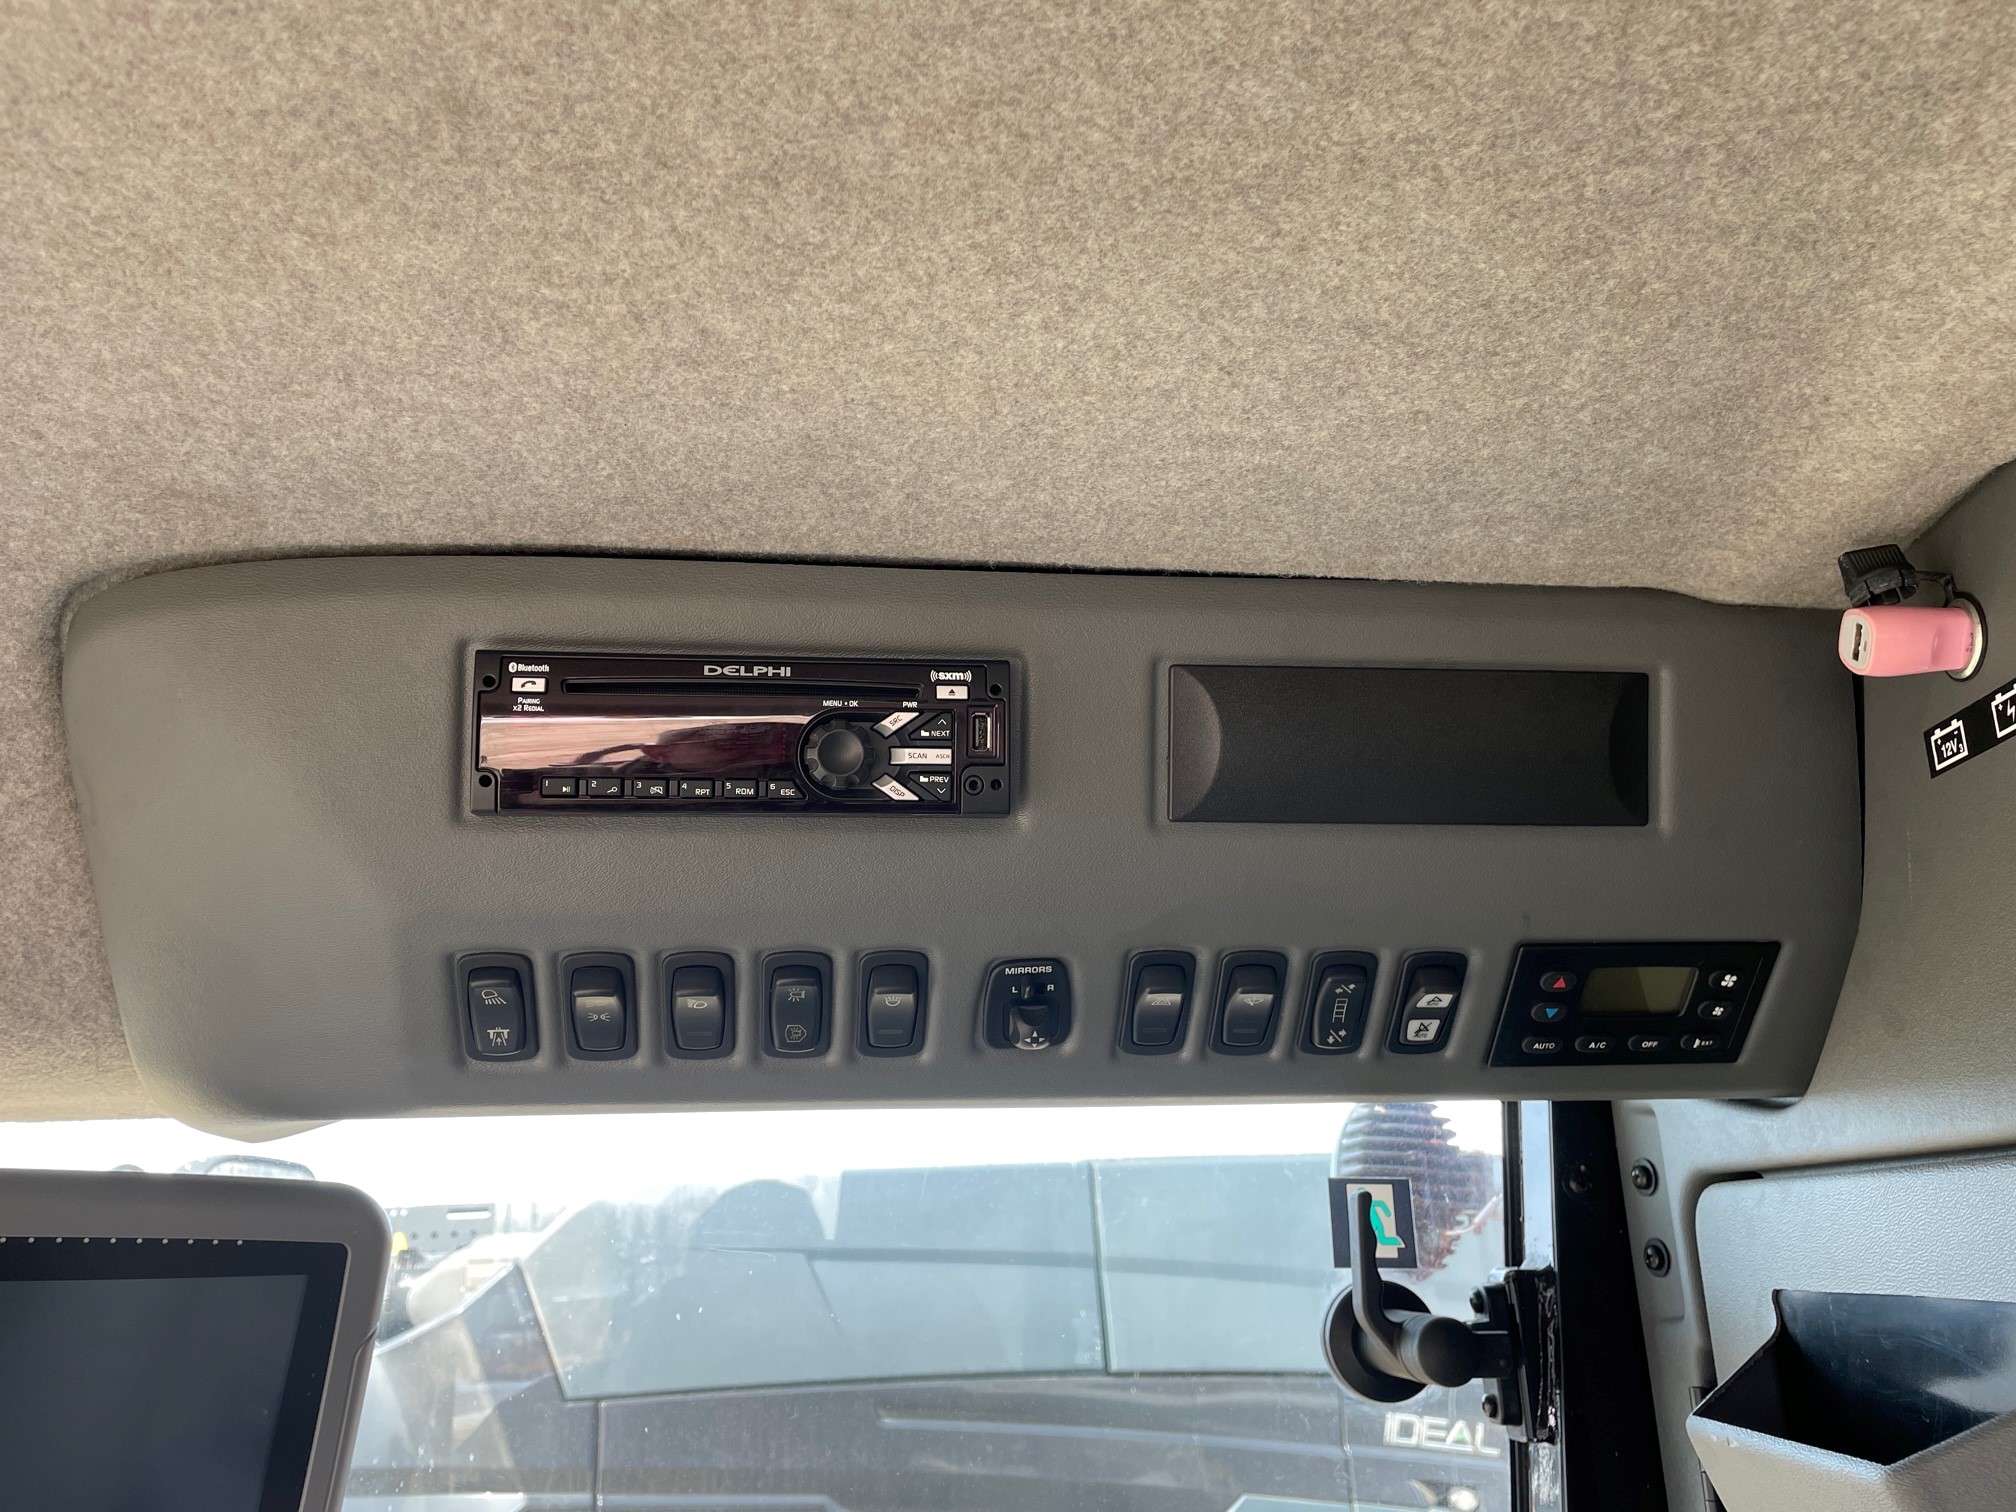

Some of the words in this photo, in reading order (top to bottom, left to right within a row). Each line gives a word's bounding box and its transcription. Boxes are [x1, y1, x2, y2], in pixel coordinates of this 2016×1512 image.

[517, 663, 550, 672] Bluetooth
[703, 665, 791, 677] DELPHI
[889, 715, 903, 727] SRC
[1941, 738, 1958, 758] 12V
[636, 781, 642, 789] 3
[695, 788, 711, 796] RPT
[889, 785, 906, 797] DISP
[1005, 966, 1052, 975] MIRRORS
[1047, 984, 1054, 992] R
[1532, 1042, 1556, 1050] AUTO
[1588, 1041, 1607, 1049] A/C
[1641, 1040, 1659, 1048] OFF
[1384, 1412, 1500, 1458] IDEAL
